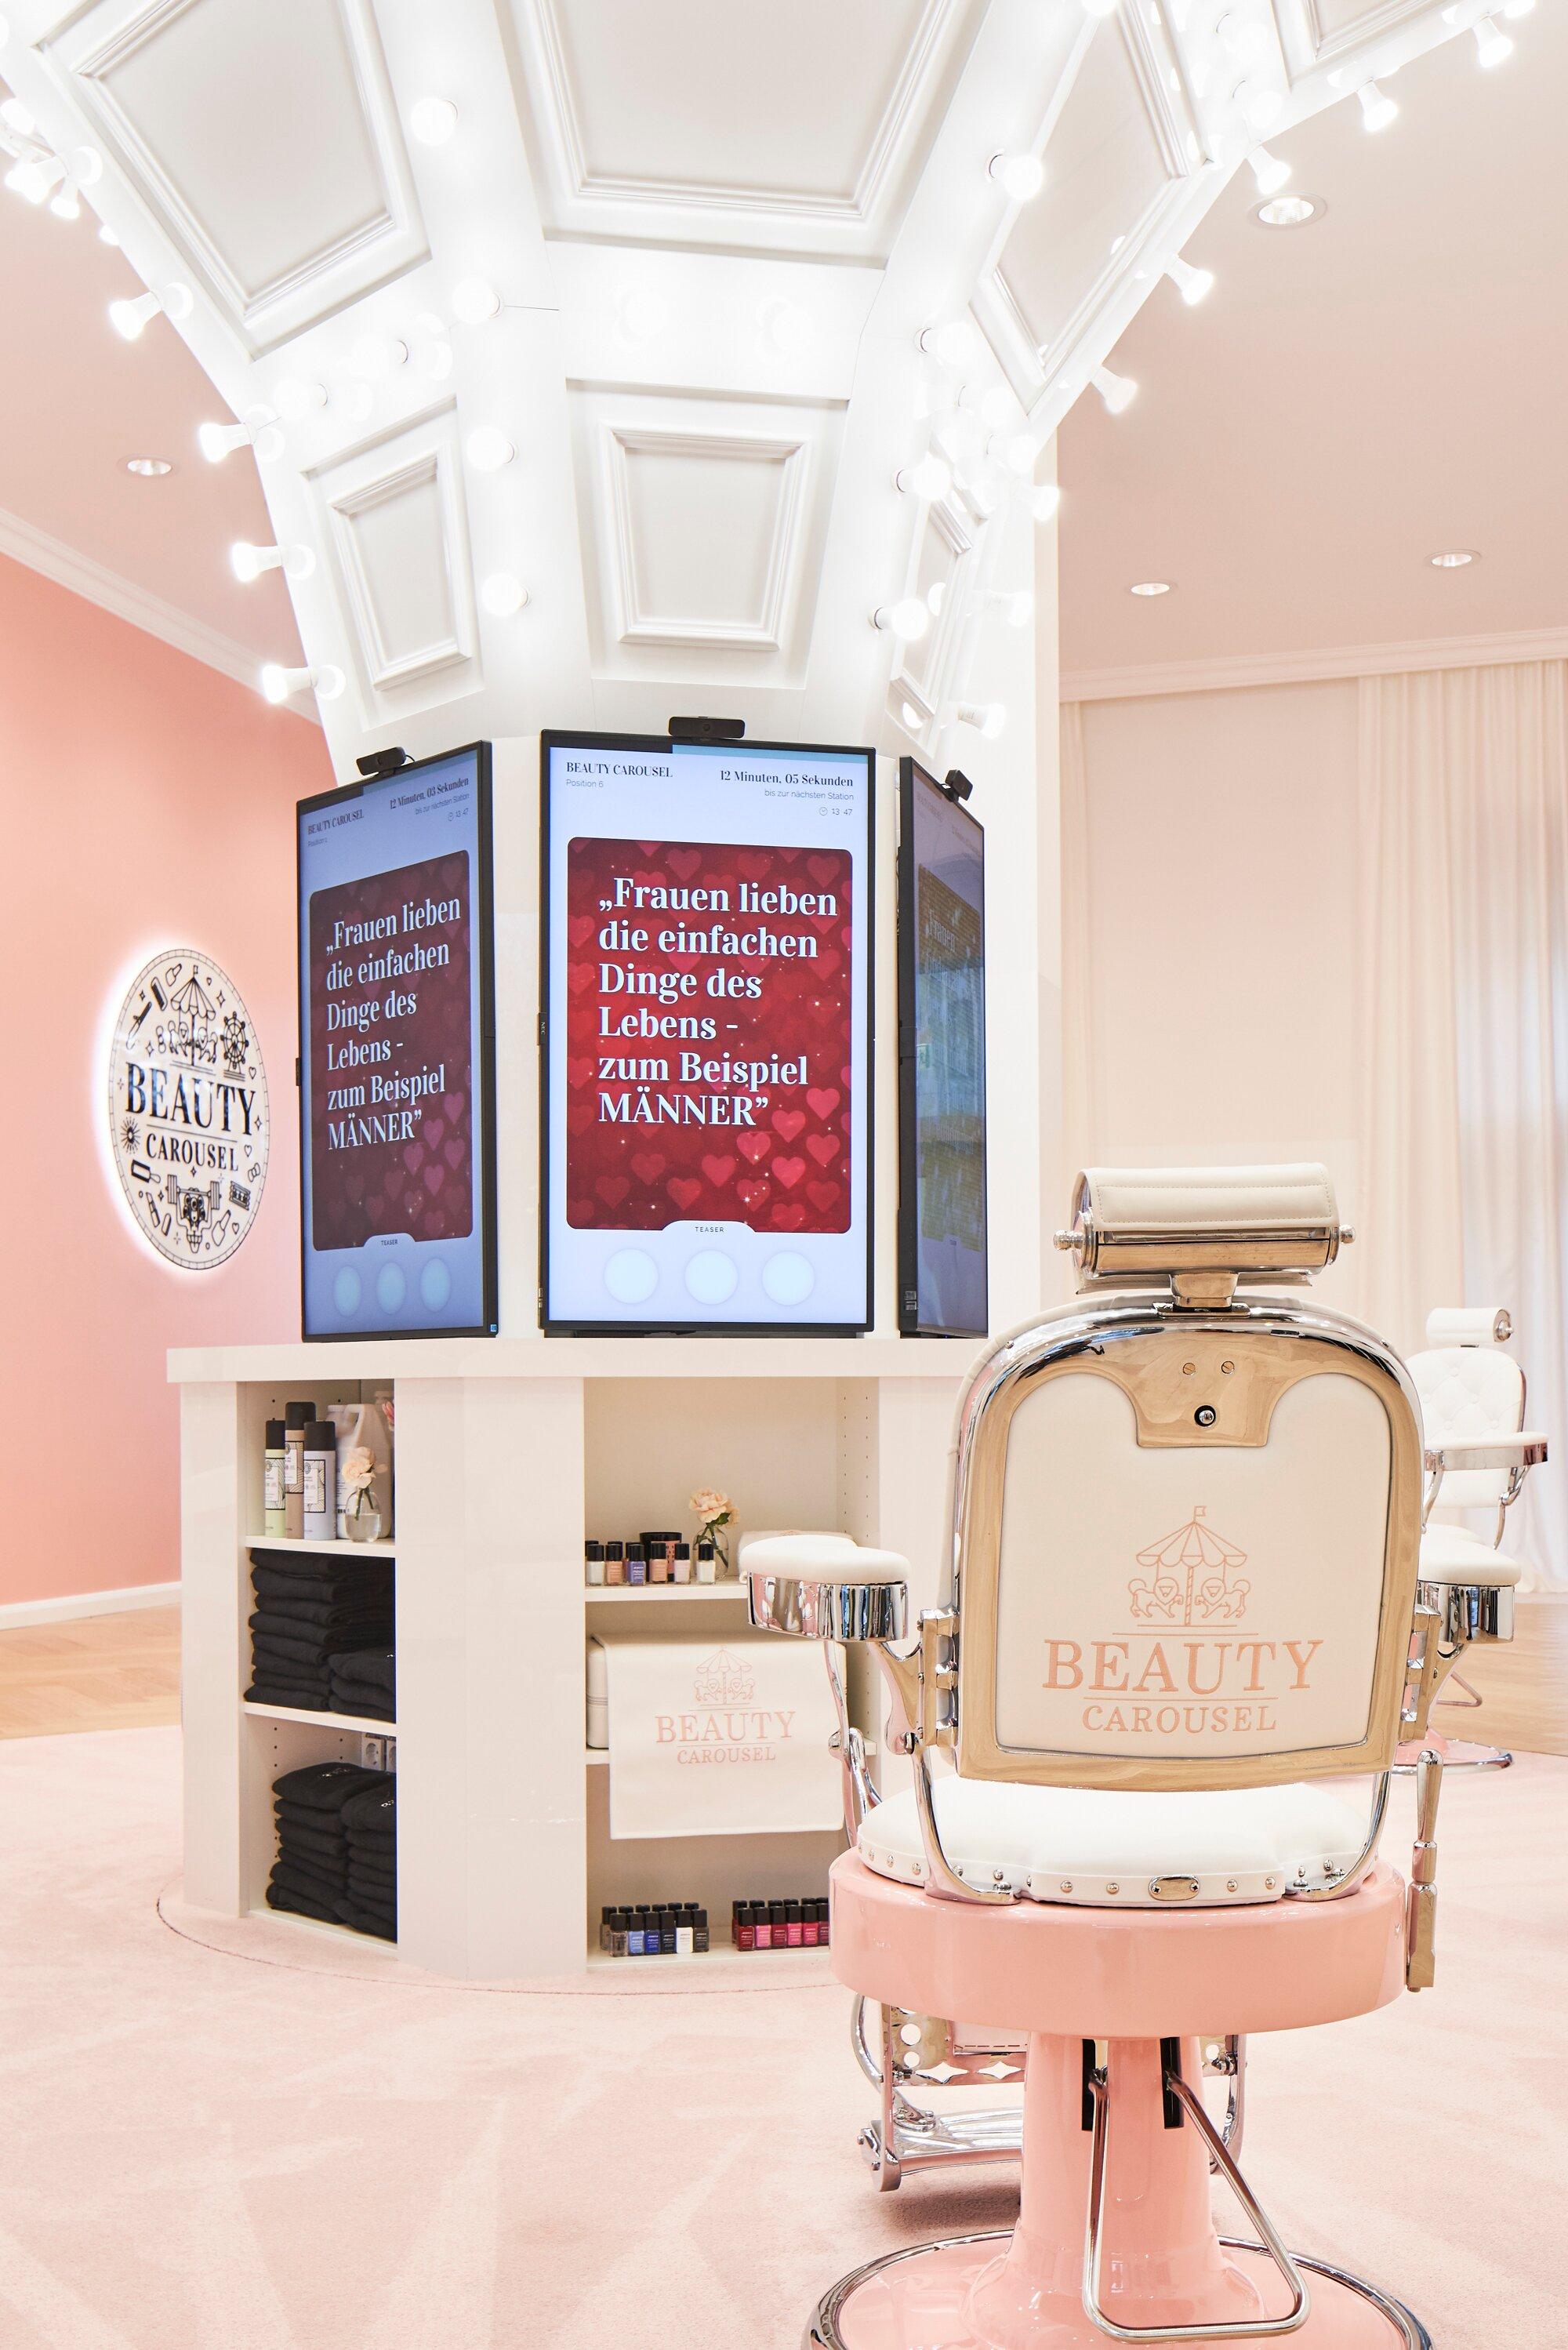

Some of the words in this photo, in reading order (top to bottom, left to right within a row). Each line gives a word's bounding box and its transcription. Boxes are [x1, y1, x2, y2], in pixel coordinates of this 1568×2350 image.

[566, 779, 596, 787] Position
[567, 761, 610, 774] BEAUTY
[613, 765, 673, 777] CAROUSEL
[720, 770, 731, 780] 12
[785, 773, 798, 784] 05
[801, 774, 853, 786] Sekunden
[437, 778, 469, 794] Sekunden
[828, 792, 855, 801] Station
[332, 809, 364, 827] CAROUSEL
[402, 898, 461, 933] lieben
[739, 882, 837, 916] lieben
[599, 920, 648, 951] die
[659, 922, 818, 957] einfachen
[326, 961, 353, 991] die
[358, 943, 450, 984] einfachen
[599, 963, 697, 1004] Dinge
[706, 968, 762, 998] des
[327, 1000, 380, 1033] Dinge
[385, 990, 416, 1019] des
[599, 1007, 717, 1040] Lebens
[328, 1039, 391, 1071] Lebens
[328, 1085, 366, 1110] zum
[371, 1063, 445, 1105] Beispiel
[599, 1057, 670, 1081] zum
[679, 1052, 808, 1092] Beispiel
[125, 1061, 256, 1136] BEAUTY
[147, 1132, 238, 1171] CAROUSEL
[1042, 1639, 1324, 1695] BEAUTY
[655, 1711, 796, 1743] BEAUTY
[1082, 1705, 1277, 1734] CAROUSEL
[677, 1747, 776, 1764] CAROUSEL
